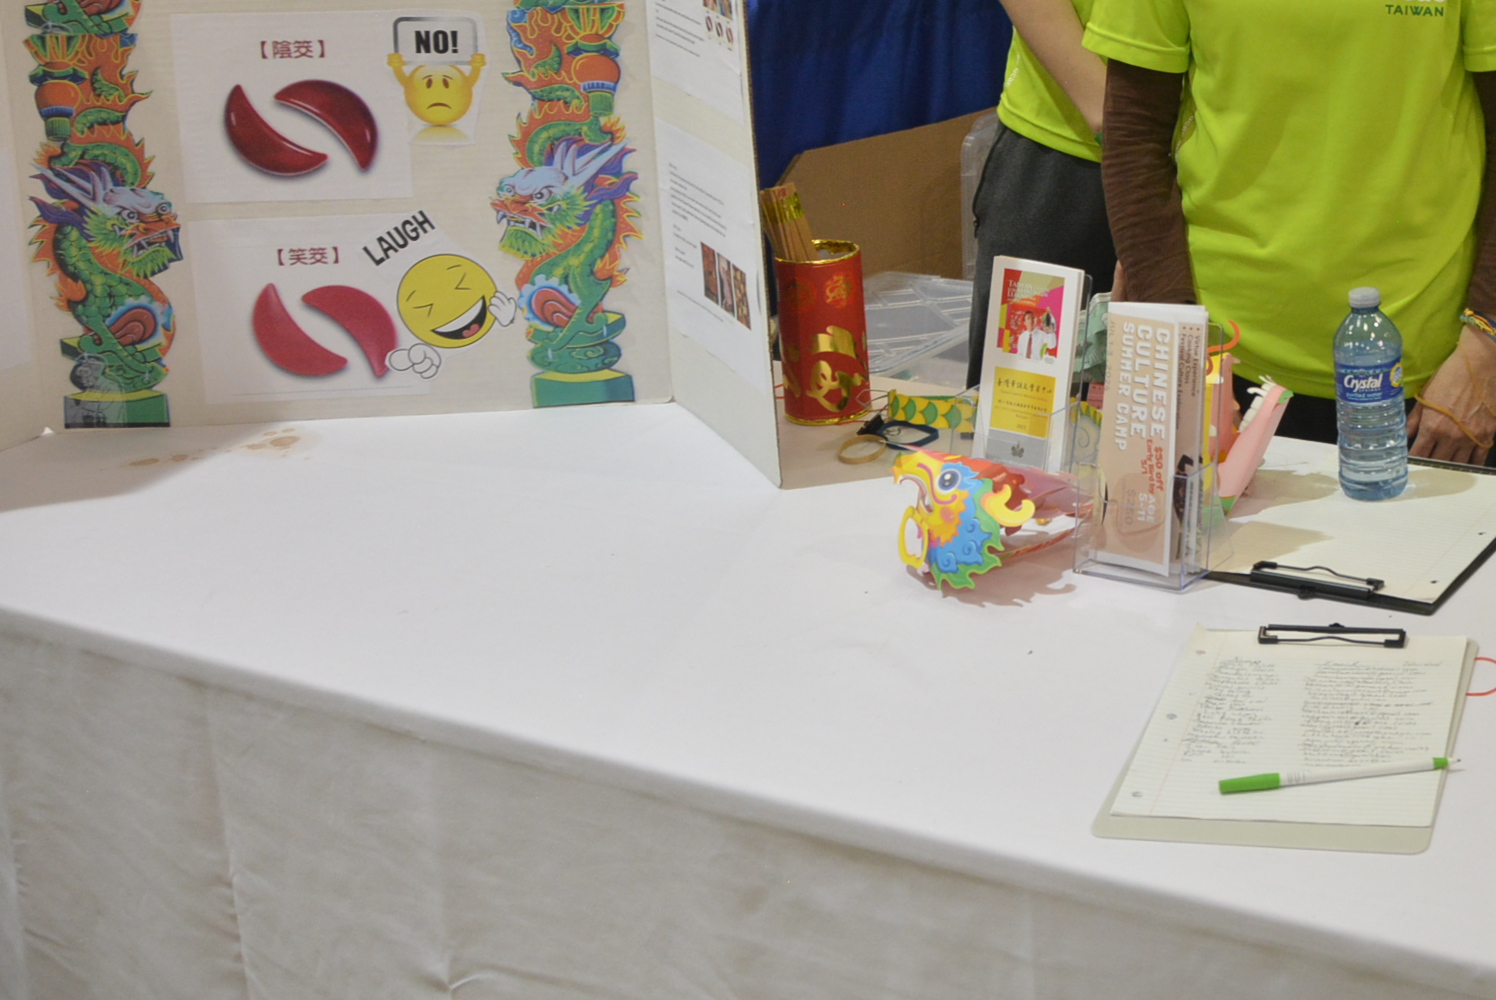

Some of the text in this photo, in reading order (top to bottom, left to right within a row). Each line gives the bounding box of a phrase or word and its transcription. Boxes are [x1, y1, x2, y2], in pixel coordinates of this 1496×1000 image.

[1385, 4, 1444, 17] TAIWAN
[414, 29, 459, 54] NO!
[362, 210, 436, 267] LAUGH
[1114, 321, 1135, 451] SUMMER CAMP
[1130, 325, 1153, 438] CULTURE
[1150, 328, 1171, 439] CHINESE
[1343, 373, 1383, 393] Crystal
[1146, 439, 1156, 495] Early Bird by
[1154, 446, 1164, 491] $50 off
